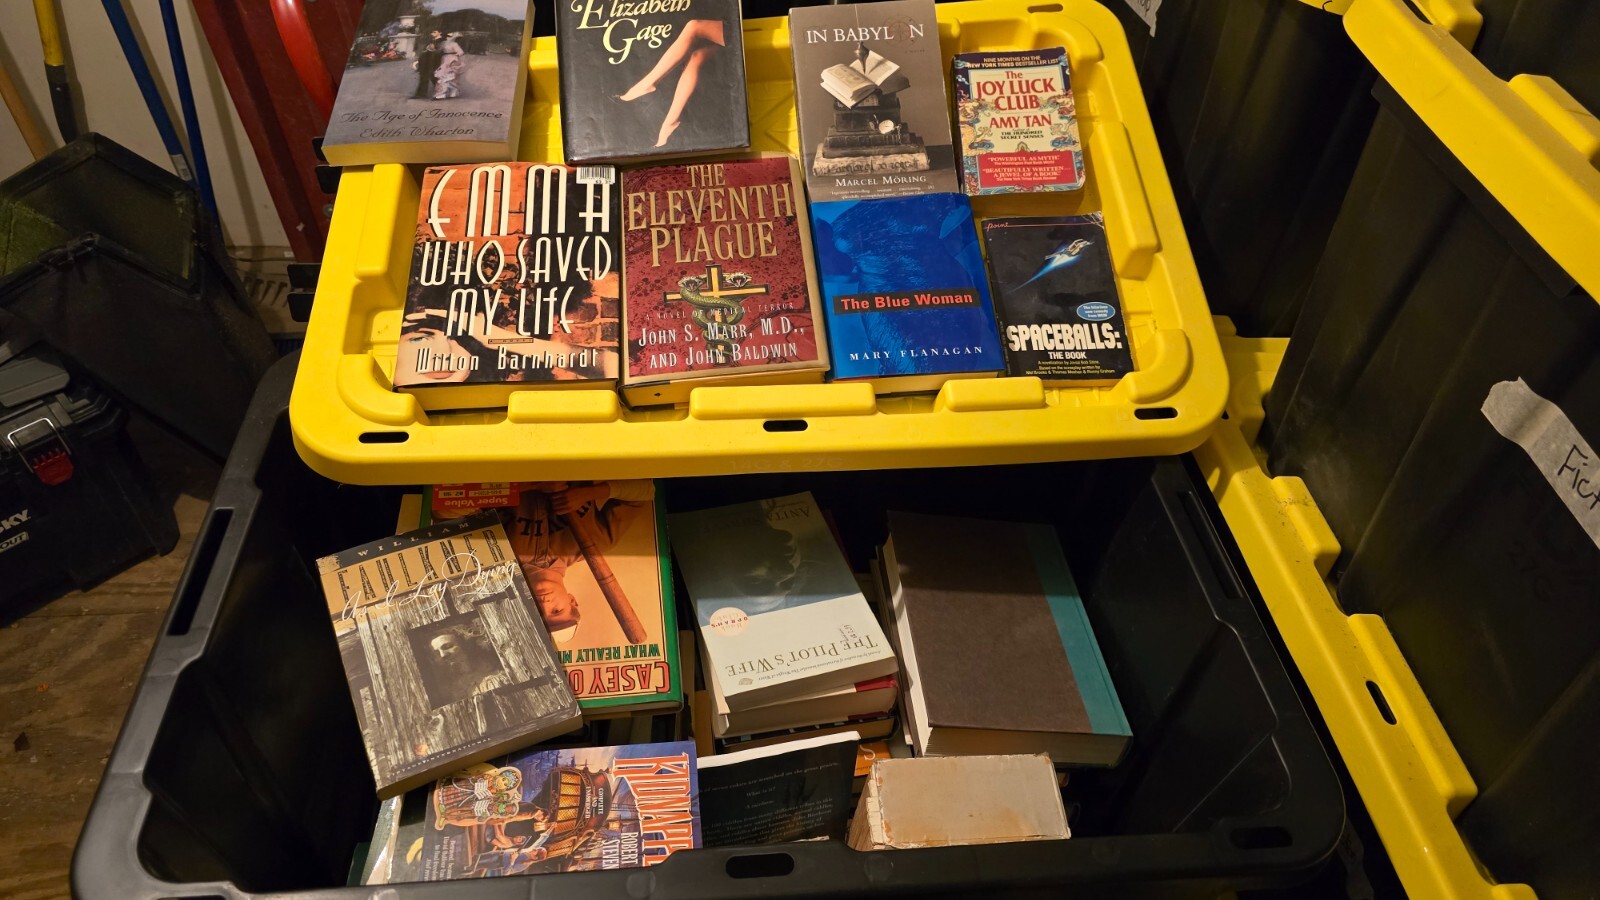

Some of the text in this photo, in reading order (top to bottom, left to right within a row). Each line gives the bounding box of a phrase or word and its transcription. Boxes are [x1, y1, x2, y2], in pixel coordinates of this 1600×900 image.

[570, 0, 691, 29] Elizabeth
[602, 18, 673, 65] Gage
[806, 30, 828, 44] IN
[1005, 71, 1024, 80] The
[975, 78, 1057, 100] JOY LUCK
[994, 94, 1041, 111] CLUB
[340, 108, 503, 124] The Age of Innocence
[989, 114, 1052, 129] AMY TAN
[360, 126, 474, 138] Edith Wharton
[686, 163, 726, 188] THE
[835, 175, 927, 187] MARCEL MÖRING
[427, 164, 611, 238] EMMA
[626, 183, 795, 232] ELEVENTH
[650, 221, 778, 268] PLAGUE
[420, 236, 612, 287] WHO SAVED
[446, 286, 576, 337] MY LIFE
[656, 311, 687, 320] NOVEL
[758, 302, 794, 313] TERROR
[841, 292, 973, 311] The Blue Woman
[638, 316, 805, 347] JOHN S. MARR, M.D.,
[1006, 323, 1123, 352] SPACEBALLS:
[416, 346, 599, 373] Wilton Barnhardt
[650, 342, 798, 369] AND JOHN BALDWIN
[850, 346, 983, 361] MARY FLANAGAN
[1048, 351, 1087, 360] THE BOOK
[444, 497, 509, 507] Super Value
[357, 521, 471, 557] WILLIAM
[337, 528, 506, 601] FAULKNER
[341, 590, 369, 622] As
[399, 570, 449, 613] Lay
[441, 548, 517, 598] Dying
[575, 645, 621, 663] REALLY
[623, 643, 661, 658] WHAT
[774, 641, 841, 667] PILOT'S
[843, 634, 879, 651] THE
[562, 661, 672, 696] CASEY O
[724, 656, 775, 677] WIFE
[613, 752, 694, 867] KIDNAPP
[602, 839, 621, 870] STEVEN
[620, 832, 639, 865] ROBERT
